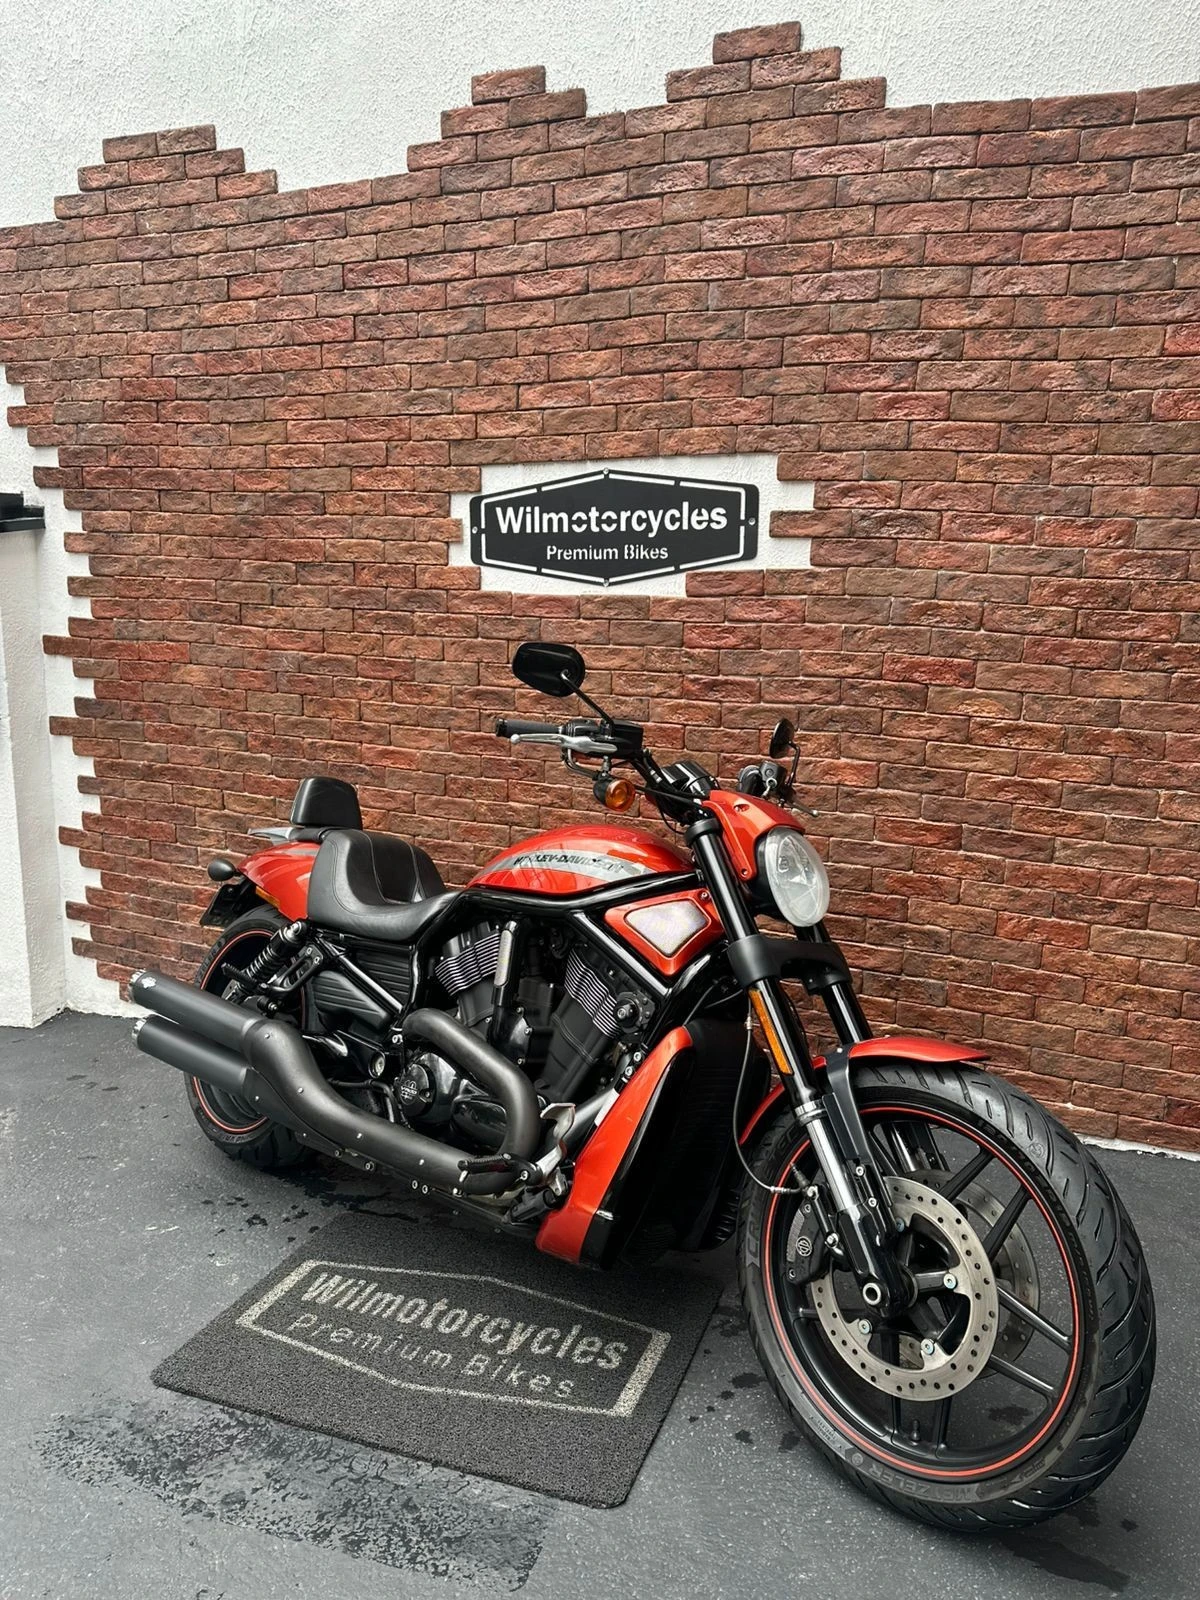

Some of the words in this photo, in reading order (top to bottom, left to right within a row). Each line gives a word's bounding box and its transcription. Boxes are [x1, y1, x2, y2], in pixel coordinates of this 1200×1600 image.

[495, 501, 728, 538] Wilmotorcycles
[546, 545, 618, 561] Premium
[624, 544, 669, 560] Bikes
[301, 1272, 628, 1370] Wilmotorcycles
[287, 1312, 452, 1369] Premium
[460, 1352, 575, 1398] Bikes
